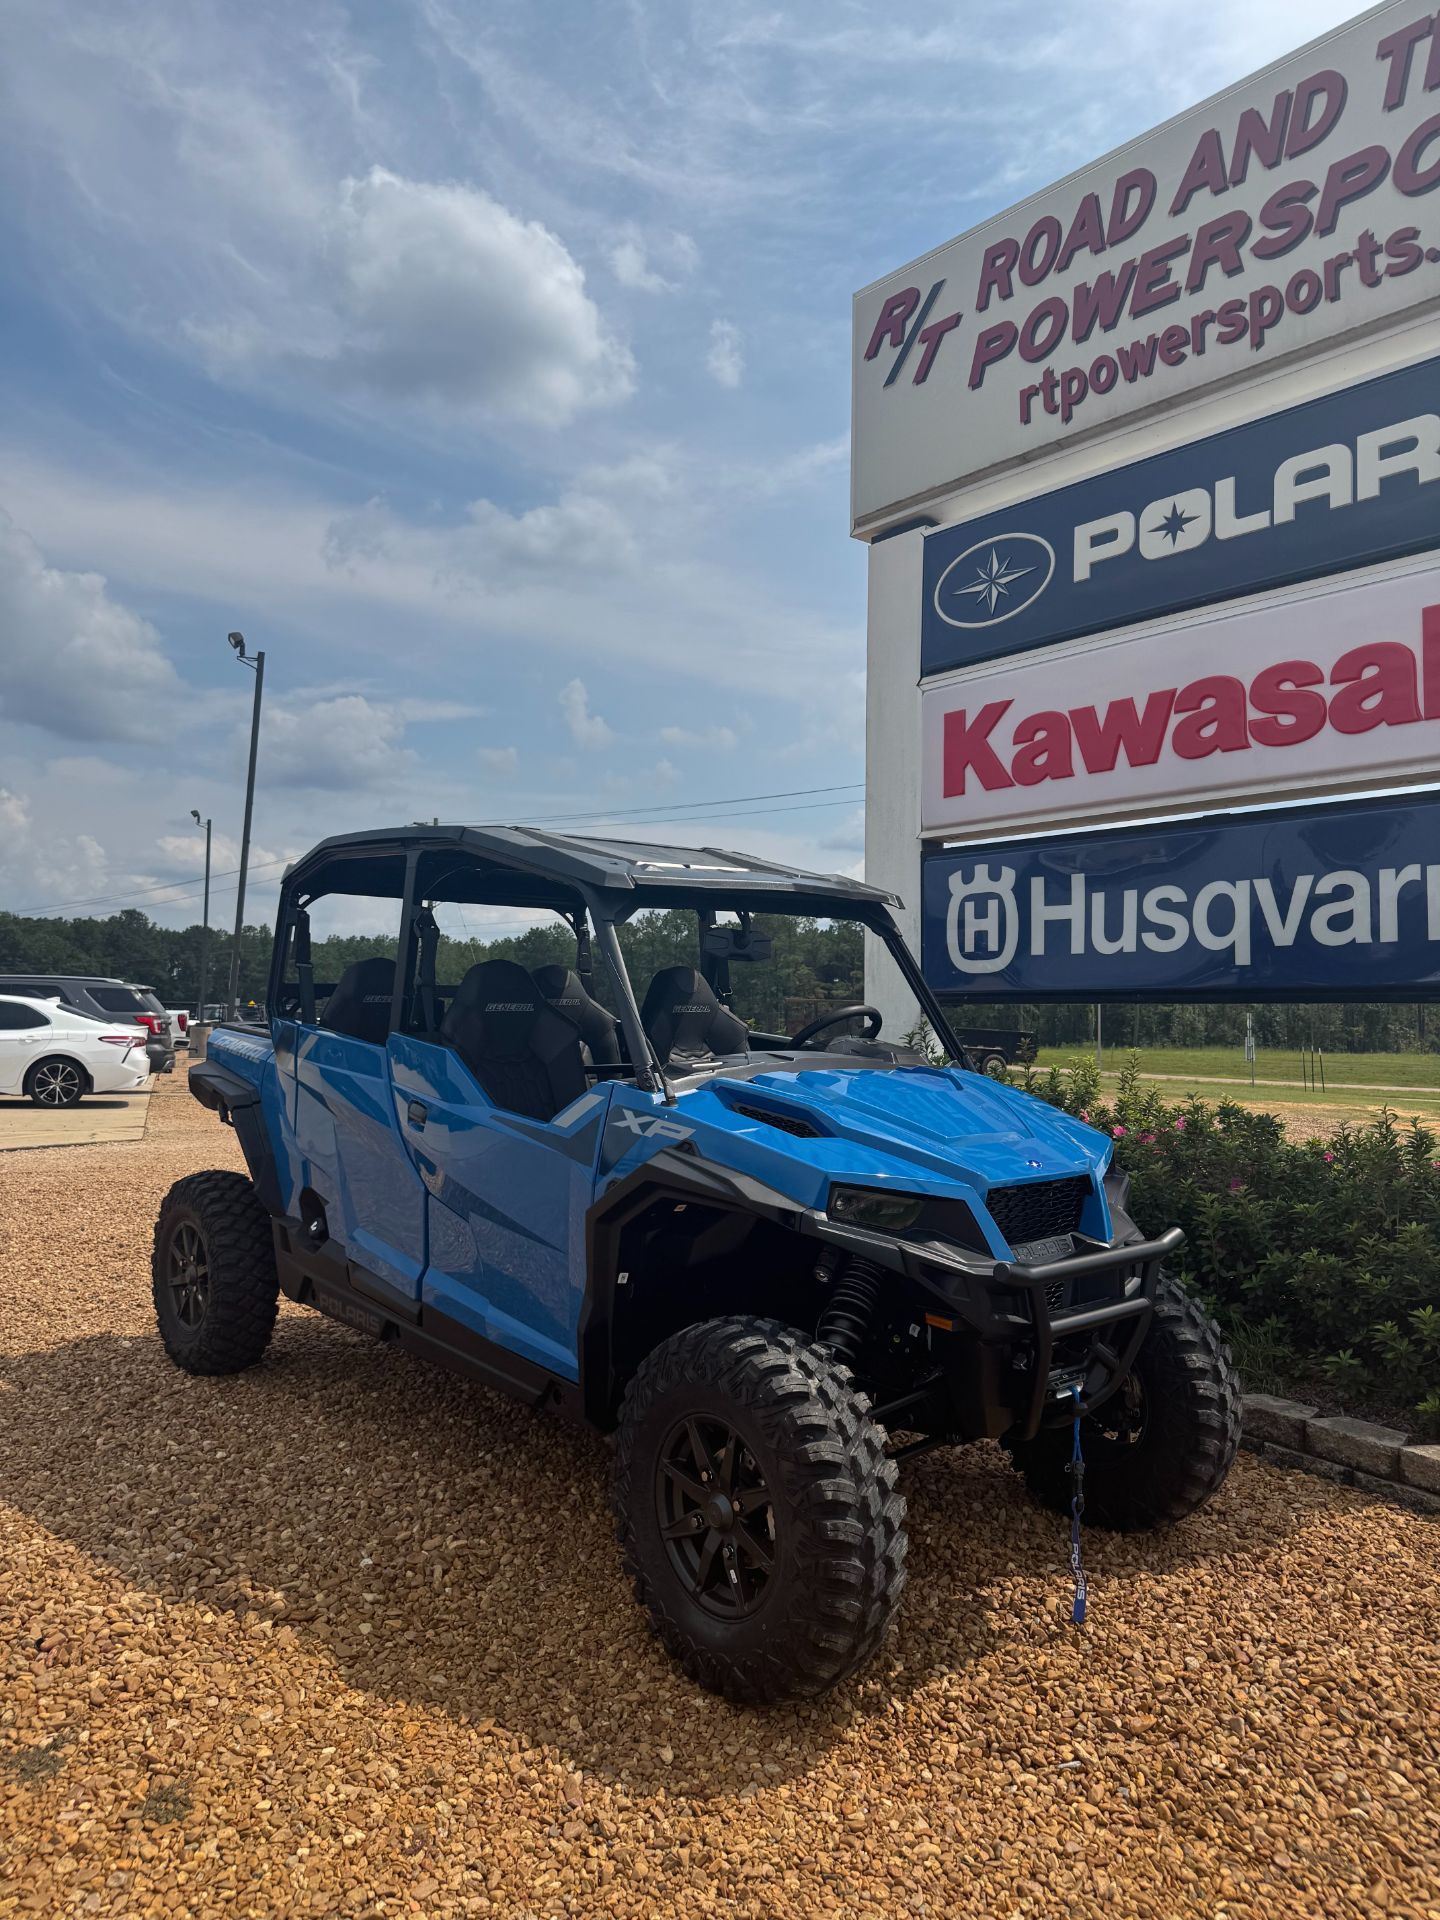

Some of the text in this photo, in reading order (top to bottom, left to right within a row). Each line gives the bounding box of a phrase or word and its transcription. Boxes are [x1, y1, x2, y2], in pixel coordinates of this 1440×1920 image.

[976, 168, 1157, 313] ROAD
[1169, 69, 1348, 217] AND
[1074, 414, 1440, 583] POLAR
[943, 605, 1440, 798] Kawasa
[1031, 864, 1440, 966] Husqvar
[609, 1108, 696, 1140] XP
[320, 1294, 379, 1331] POLARIS
[1071, 1542, 1086, 1600] POLARIS
